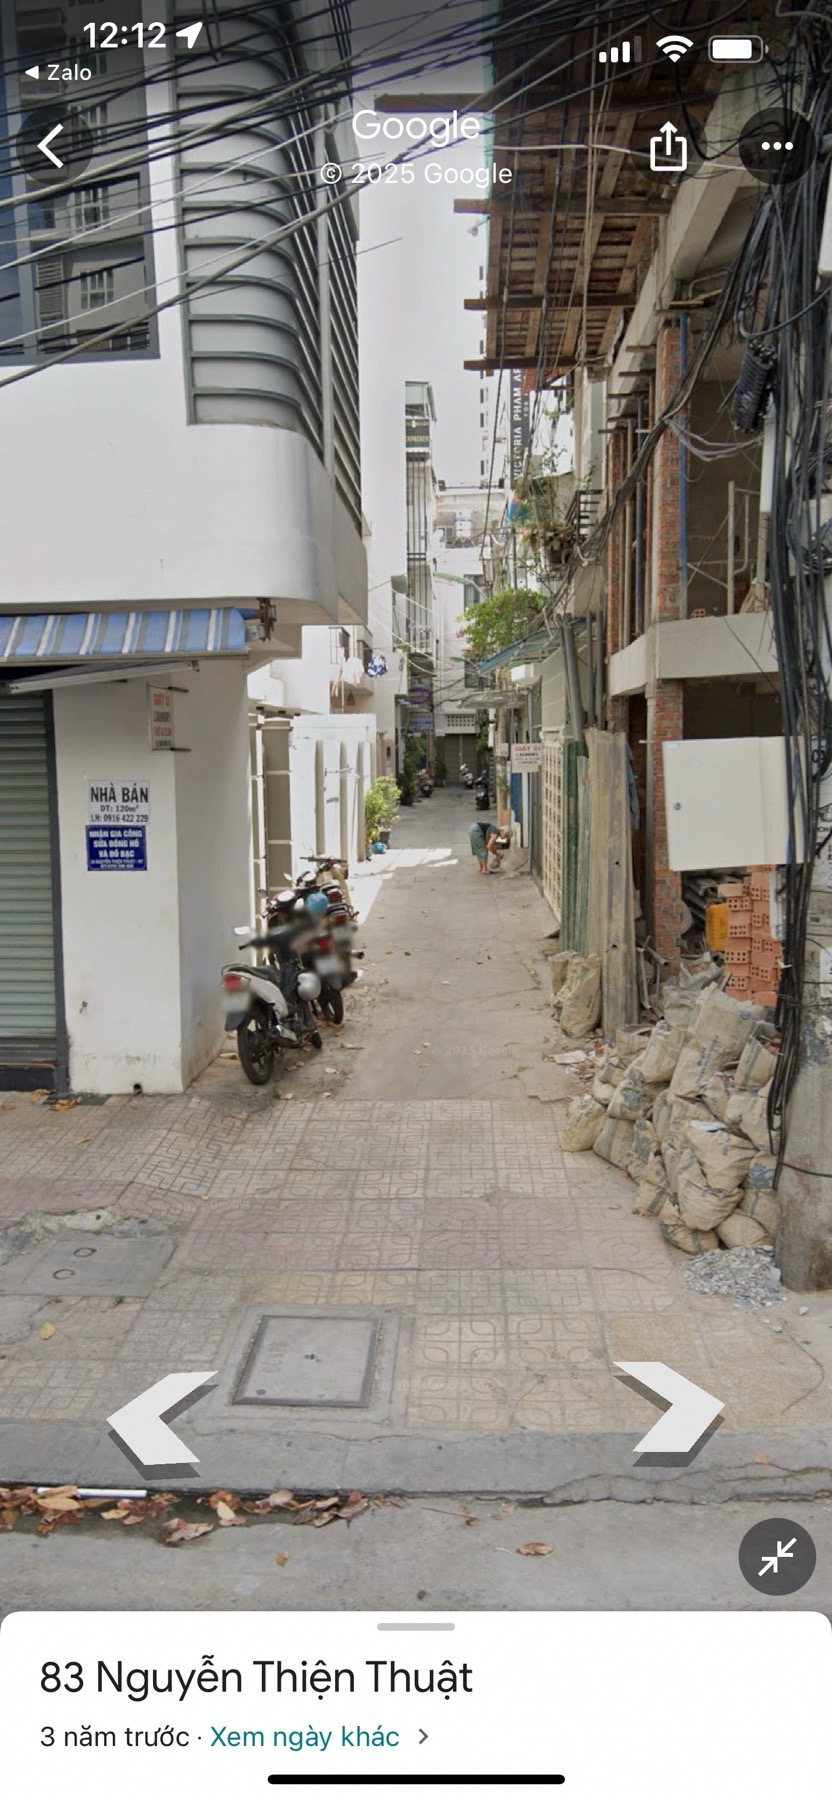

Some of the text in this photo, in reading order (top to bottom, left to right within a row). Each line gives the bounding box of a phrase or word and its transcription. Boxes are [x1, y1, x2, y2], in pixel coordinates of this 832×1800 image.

[513, 388, 522, 421] PHAM
[91, 782, 148, 803] NHÀ BÁN
[90, 814, 149, 823] LH: 0916 422 229
[123, 829, 143, 837] CÔNG
[98, 849, 108, 858] VÀ
[120, 850, 135, 859] BẠC
